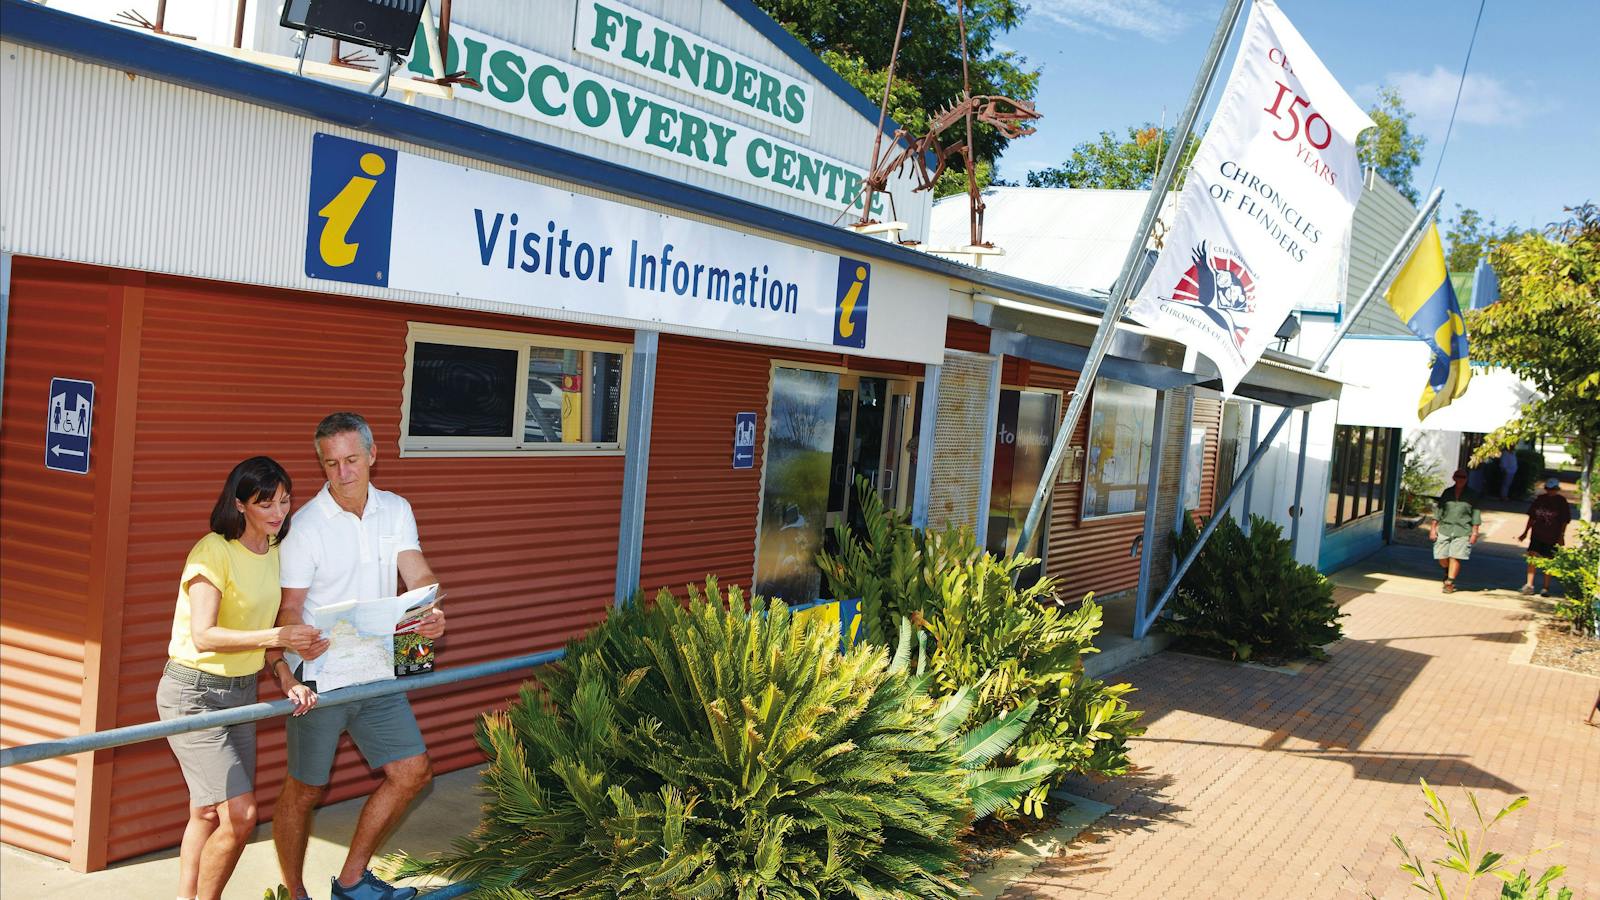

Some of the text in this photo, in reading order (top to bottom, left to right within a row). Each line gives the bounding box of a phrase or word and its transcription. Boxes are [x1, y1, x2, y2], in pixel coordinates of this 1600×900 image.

[408, 21, 737, 167] DISCOVERY
[591, 3, 806, 124] FLINDERS
[1264, 80, 1332, 150] 150
[1220, 161, 1322, 244] CHRONICLES
[1296, 143, 1338, 186] YEARS
[474, 208, 798, 314] Visitor Information
[1209, 183, 1308, 262] OF FLINDERS
[999, 423, 1015, 444] to
